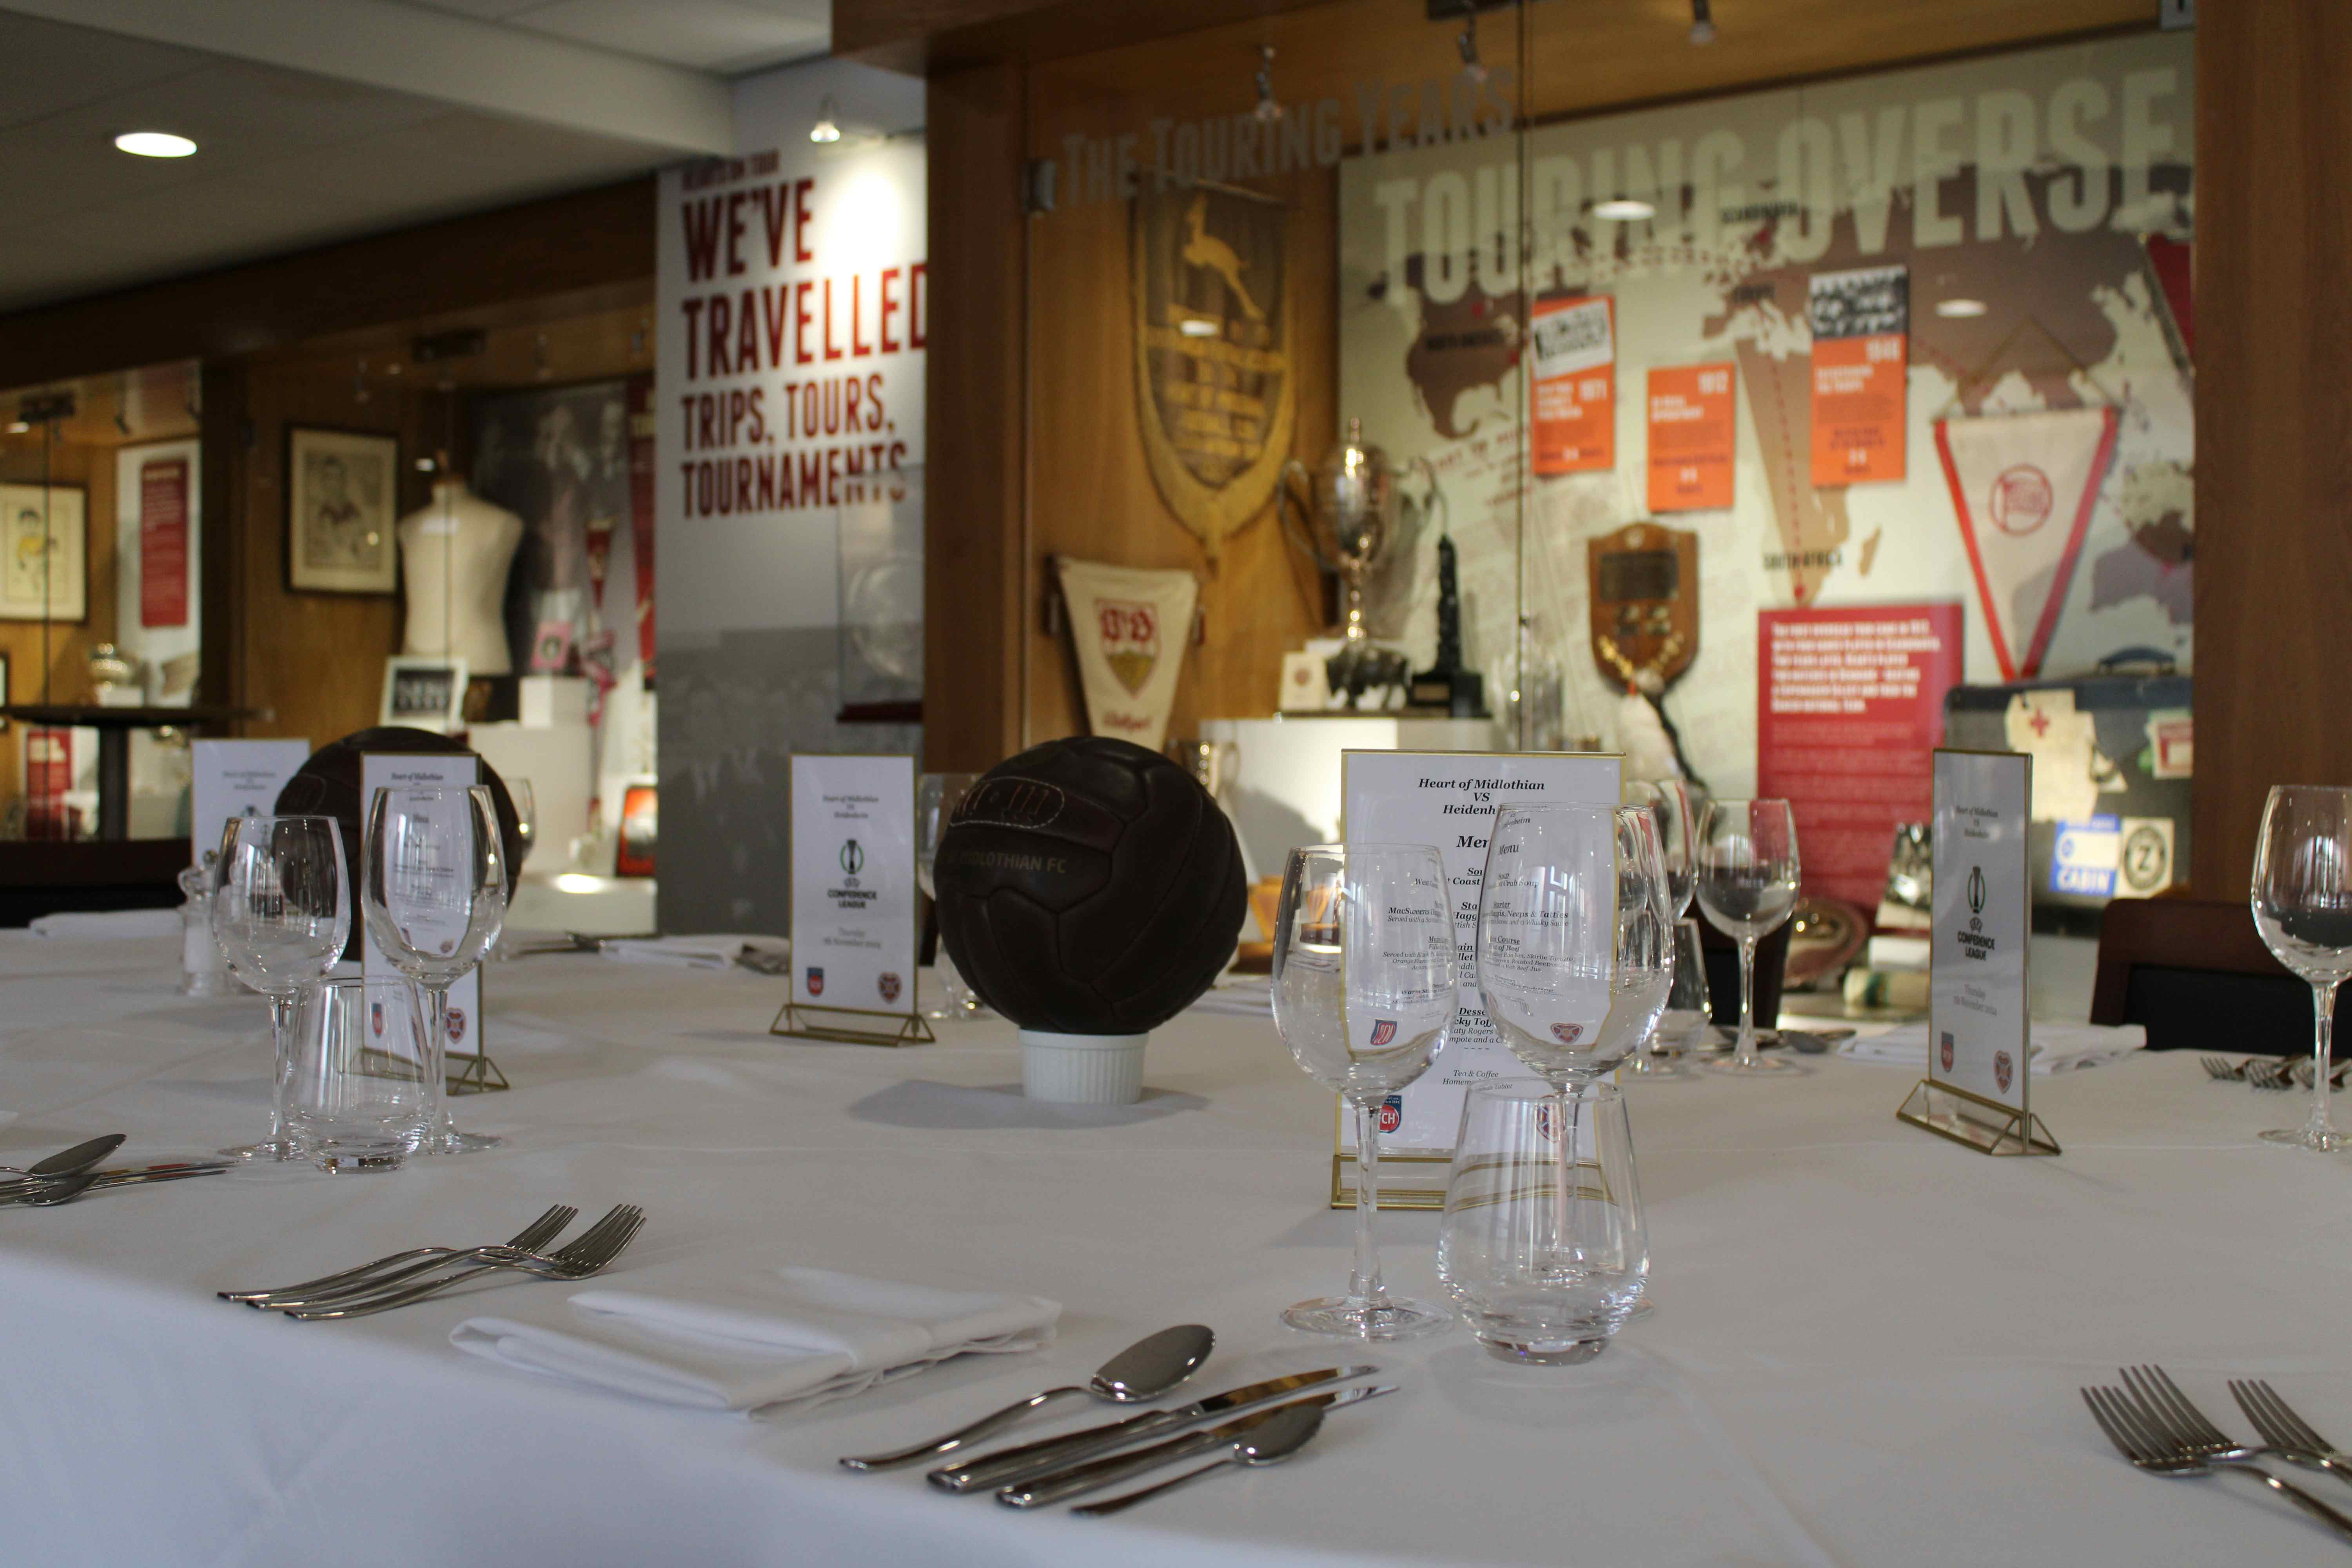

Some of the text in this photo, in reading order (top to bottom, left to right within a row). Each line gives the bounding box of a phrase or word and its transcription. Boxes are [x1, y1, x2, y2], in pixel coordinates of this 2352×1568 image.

[1148, 97, 1341, 194] TOURING
[1376, 127, 1748, 307] TOURING
[683, 176, 813, 283] WE'VE
[682, 441, 907, 518] TOURNAMENTS
[1418, 779, 1544, 791] Heart of Midlothian
[1474, 792, 1490, 802] VS
[1047, 856, 1067, 874] FC
[1507, 910, 1528, 918] Neeps
[1498, 936, 1520, 944] Course
[1958, 930, 1995, 951] CONFERENCE
[1965, 946, 1986, 961] LEAGUE
[1468, 1027, 1493, 1036] Rogers
[1476, 1070, 1499, 1079] Coffee
